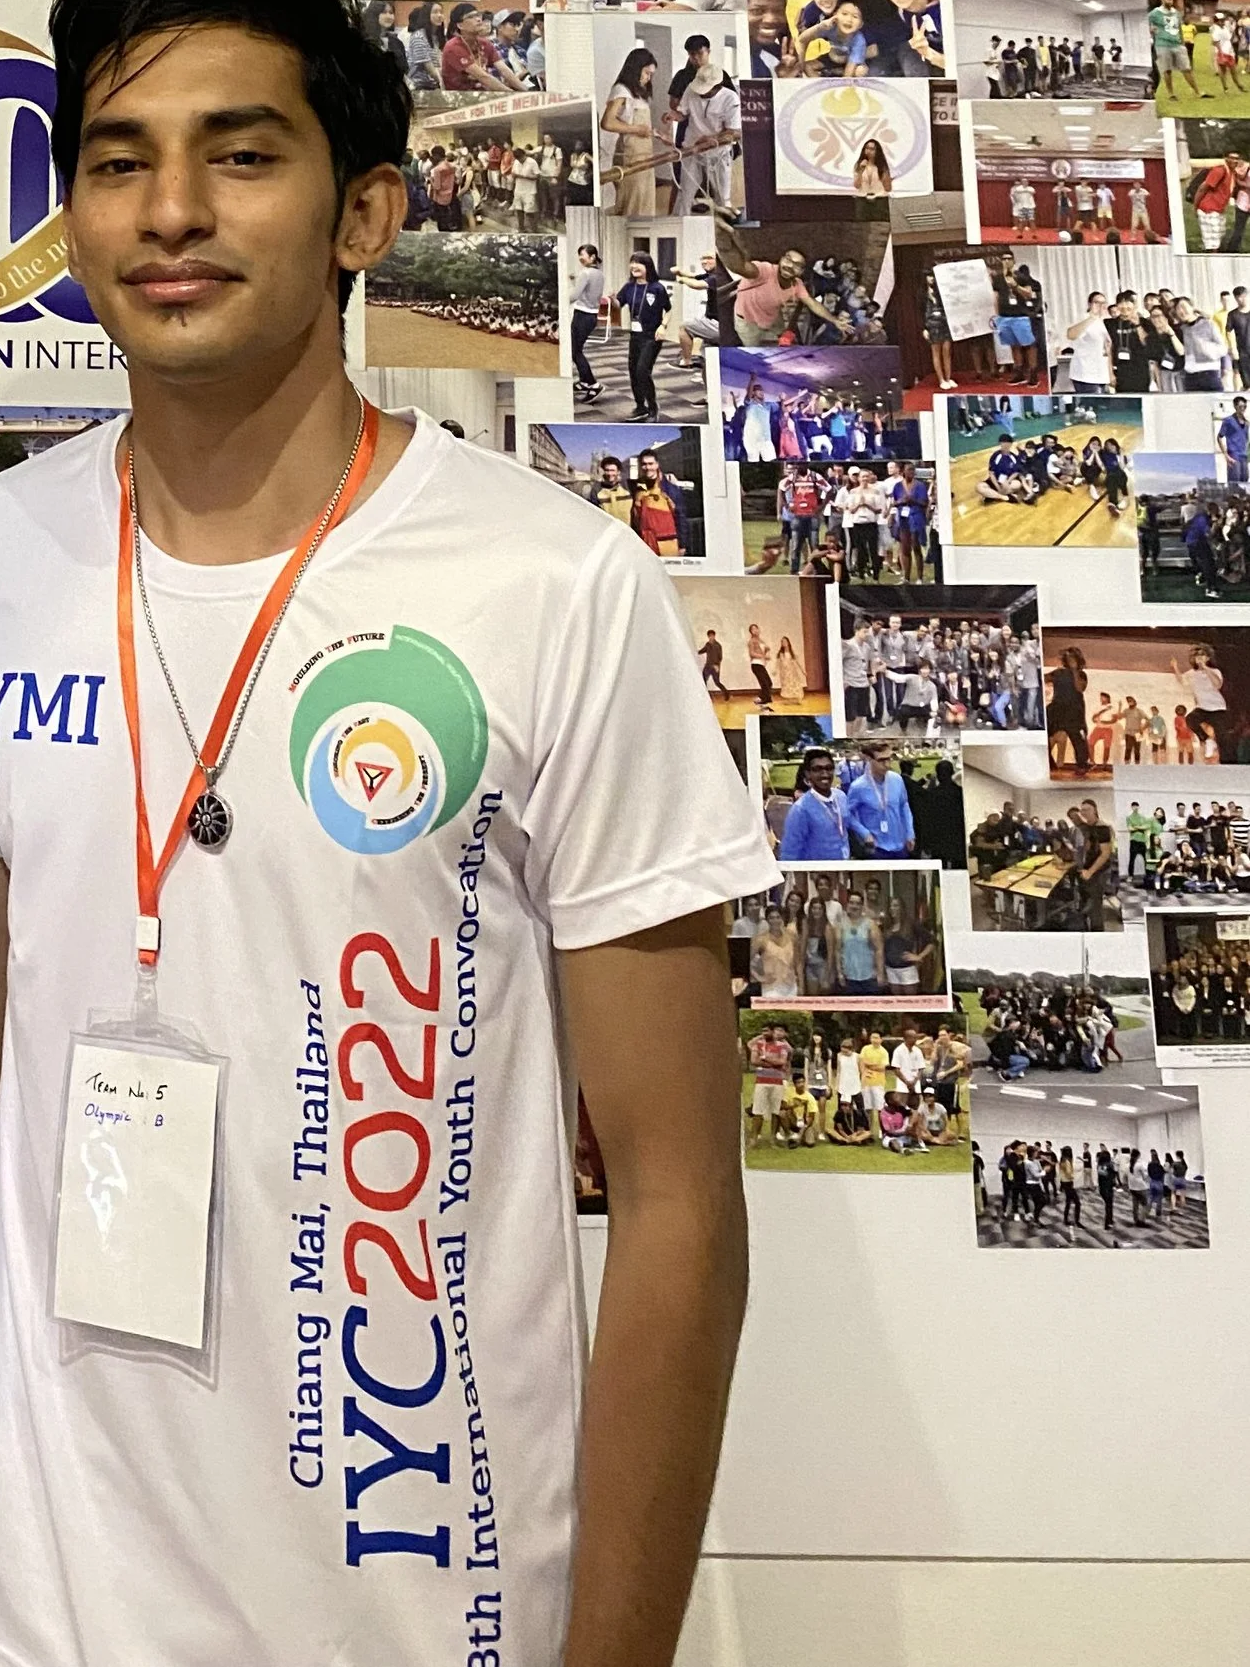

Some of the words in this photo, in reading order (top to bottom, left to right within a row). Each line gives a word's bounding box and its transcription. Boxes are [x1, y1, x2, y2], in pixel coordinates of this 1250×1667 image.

[470, 107, 486, 117] FOR
[489, 101, 508, 114] THE
[7, 259, 47, 289] the
[25, 341, 129, 370] INTER
[288, 651, 324, 693] MOULDING
[325, 640, 344, 653] THE
[347, 633, 385, 645] FUTURE
[451, 790, 502, 1058] Convocation
[155, 1084, 168, 1100] 5
[294, 979, 329, 1181] Thailand
[154, 1114, 164, 1127] B
[440, 1075, 475, 1215] Youth
[290, 1203, 331, 1293] Mai,
[290, 1313, 331, 1489] Chiang
[438, 1232, 499, 1571] International
